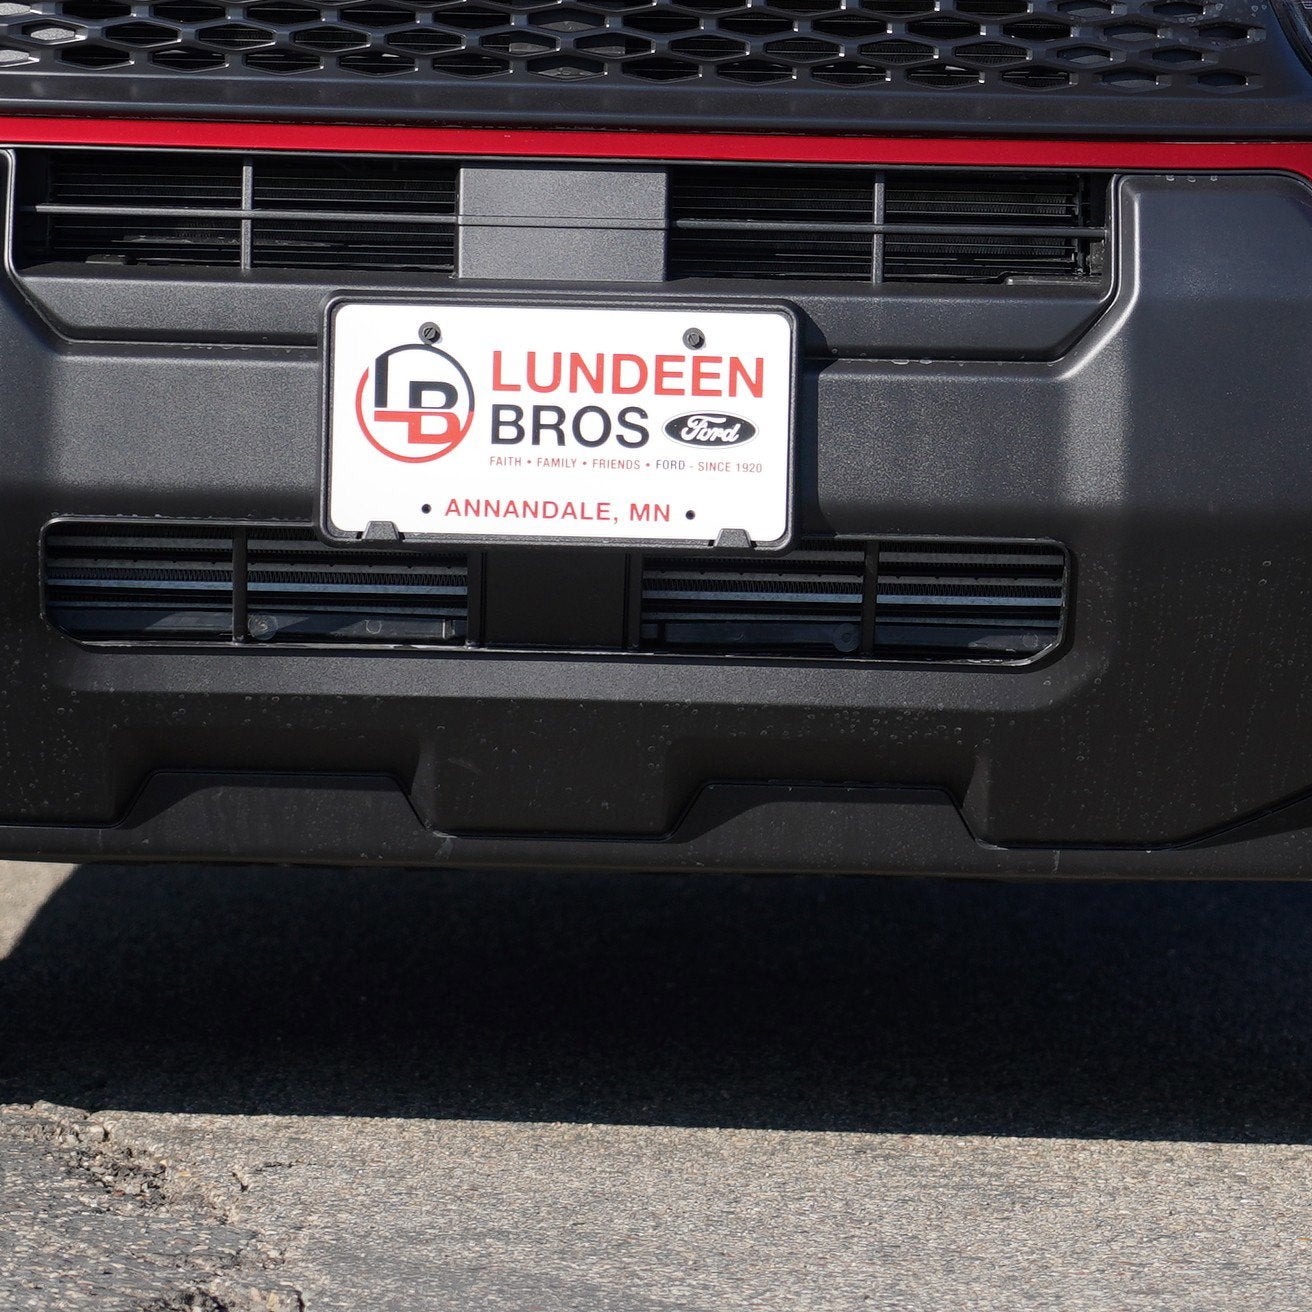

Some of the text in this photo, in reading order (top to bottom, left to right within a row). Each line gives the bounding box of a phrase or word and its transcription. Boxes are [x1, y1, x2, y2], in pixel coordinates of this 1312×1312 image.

[492, 350, 765, 399] LUNDEEN
[491, 403, 650, 449] BROS
[680, 415, 741, 442] Ford
[489, 456, 763, 473] FAITH FAMILY FRIENDS FORD SINCE 1920
[444, 498, 671, 524] ANNANDALE, MN
